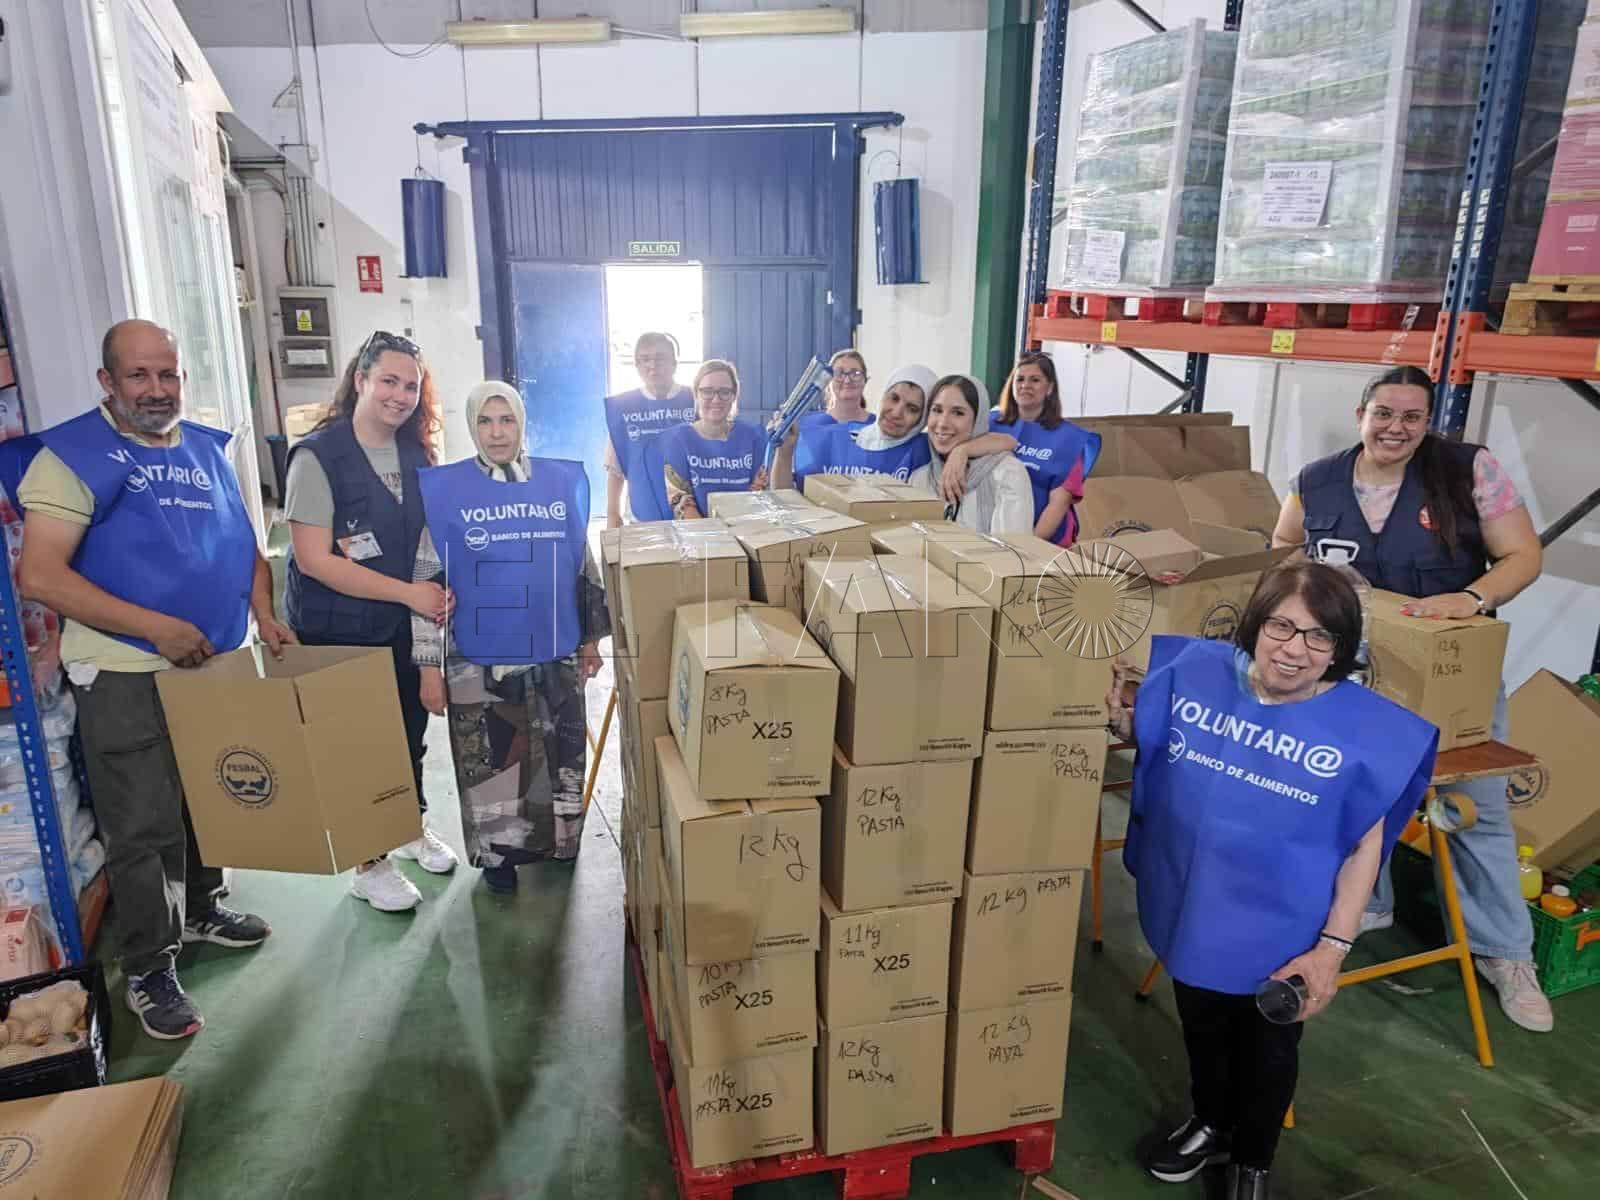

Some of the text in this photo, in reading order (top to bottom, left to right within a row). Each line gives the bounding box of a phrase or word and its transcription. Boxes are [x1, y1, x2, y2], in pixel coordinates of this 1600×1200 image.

[631, 244, 676, 254] SALIDA
[751, 721, 793, 740] X25
[1171, 693, 1343, 778] VOLUNTARI@
[1186, 749, 1320, 806] BANCO DE ALIMENTOS
[857, 814, 905, 838] PASTA
[873, 953, 910, 973] X25
[735, 989, 774, 1011] X25
[735, 1092, 773, 1113] X25
